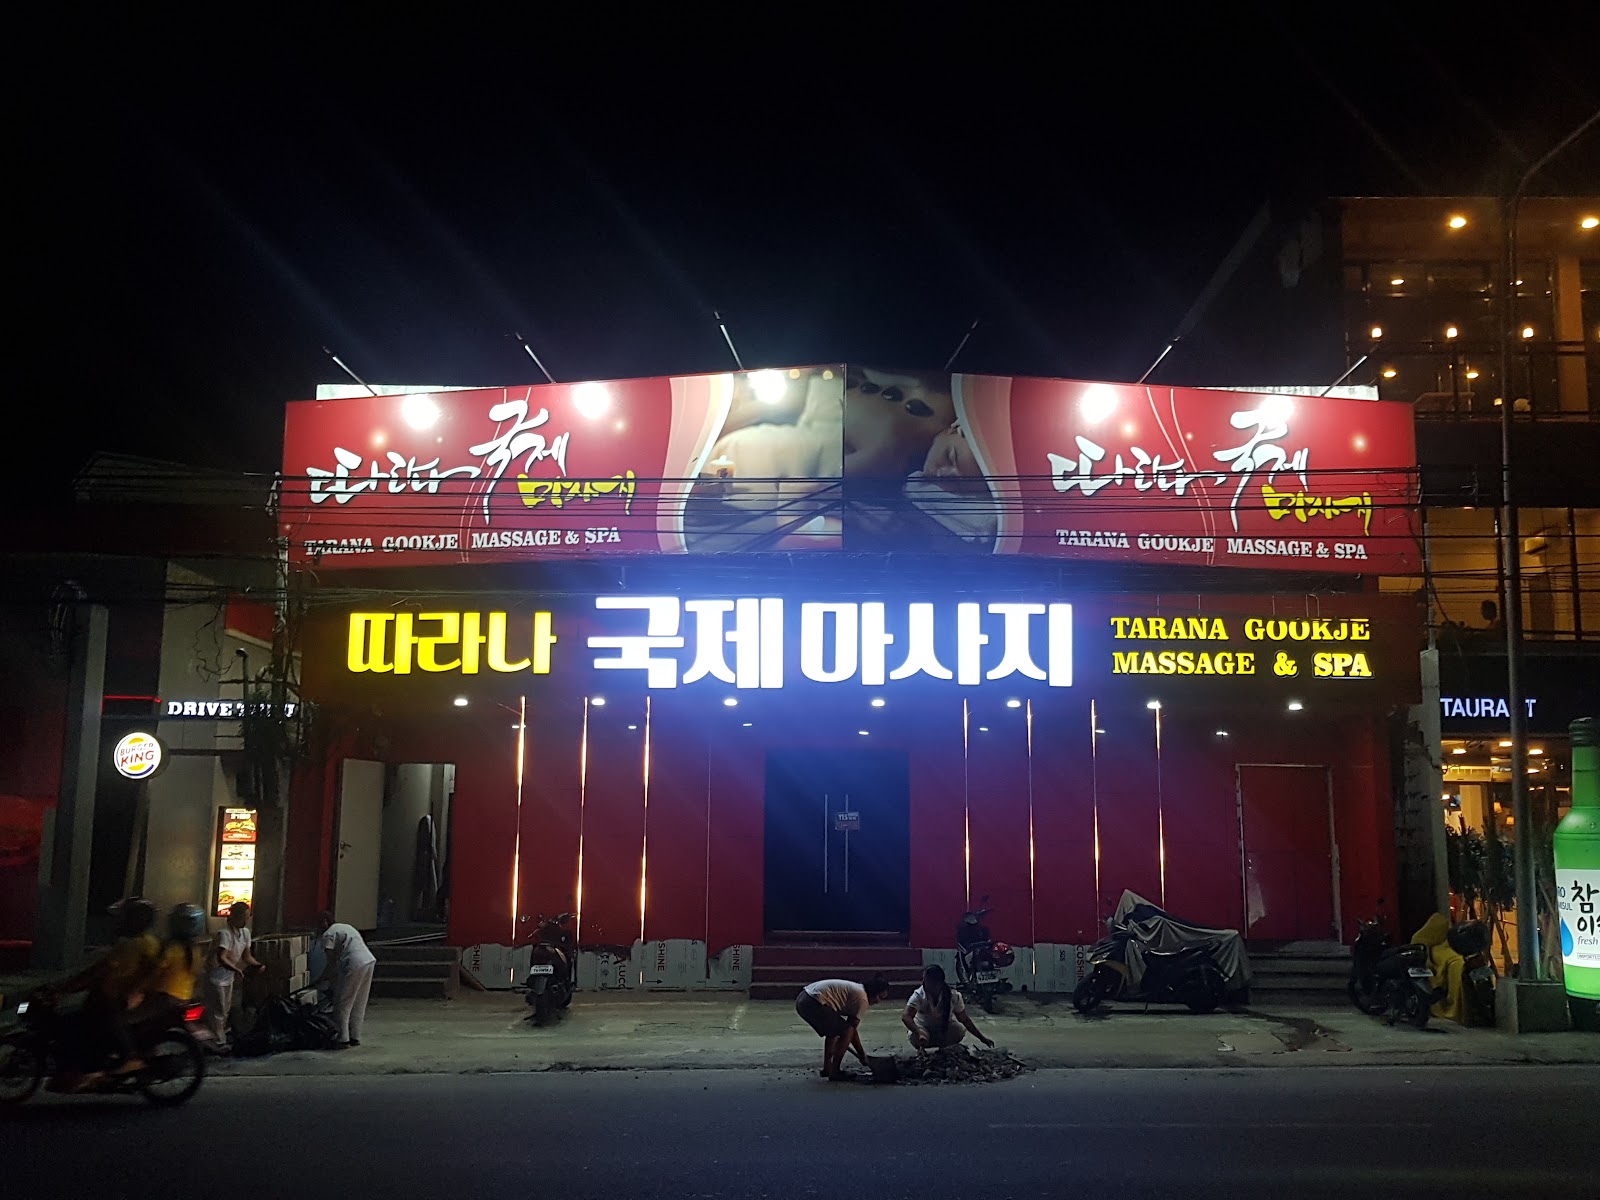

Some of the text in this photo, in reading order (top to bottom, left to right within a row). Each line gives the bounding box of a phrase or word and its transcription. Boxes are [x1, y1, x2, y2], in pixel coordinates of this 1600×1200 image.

[469, 400, 570, 525] 국제
[304, 527, 621, 555] TARANA GOOKJE MASSAGE & SPA
[1056, 529, 1368, 560] TARANA GOOKJE MASSAGE & SPA
[1111, 617, 1370, 641] TARANA GOOKJE
[347, 597, 1073, 689] 따라나 국제 마사지
[1113, 651, 1372, 677] MASSAGE & SPA
[167, 701, 232, 717] DRIVE
[1440, 698, 1536, 717] TAURAT
[121, 750, 154, 767] KING
[1571, 880, 1599, 913] 참
[1577, 935, 1599, 946] fresh
[657, 942, 665, 971] SHINE
